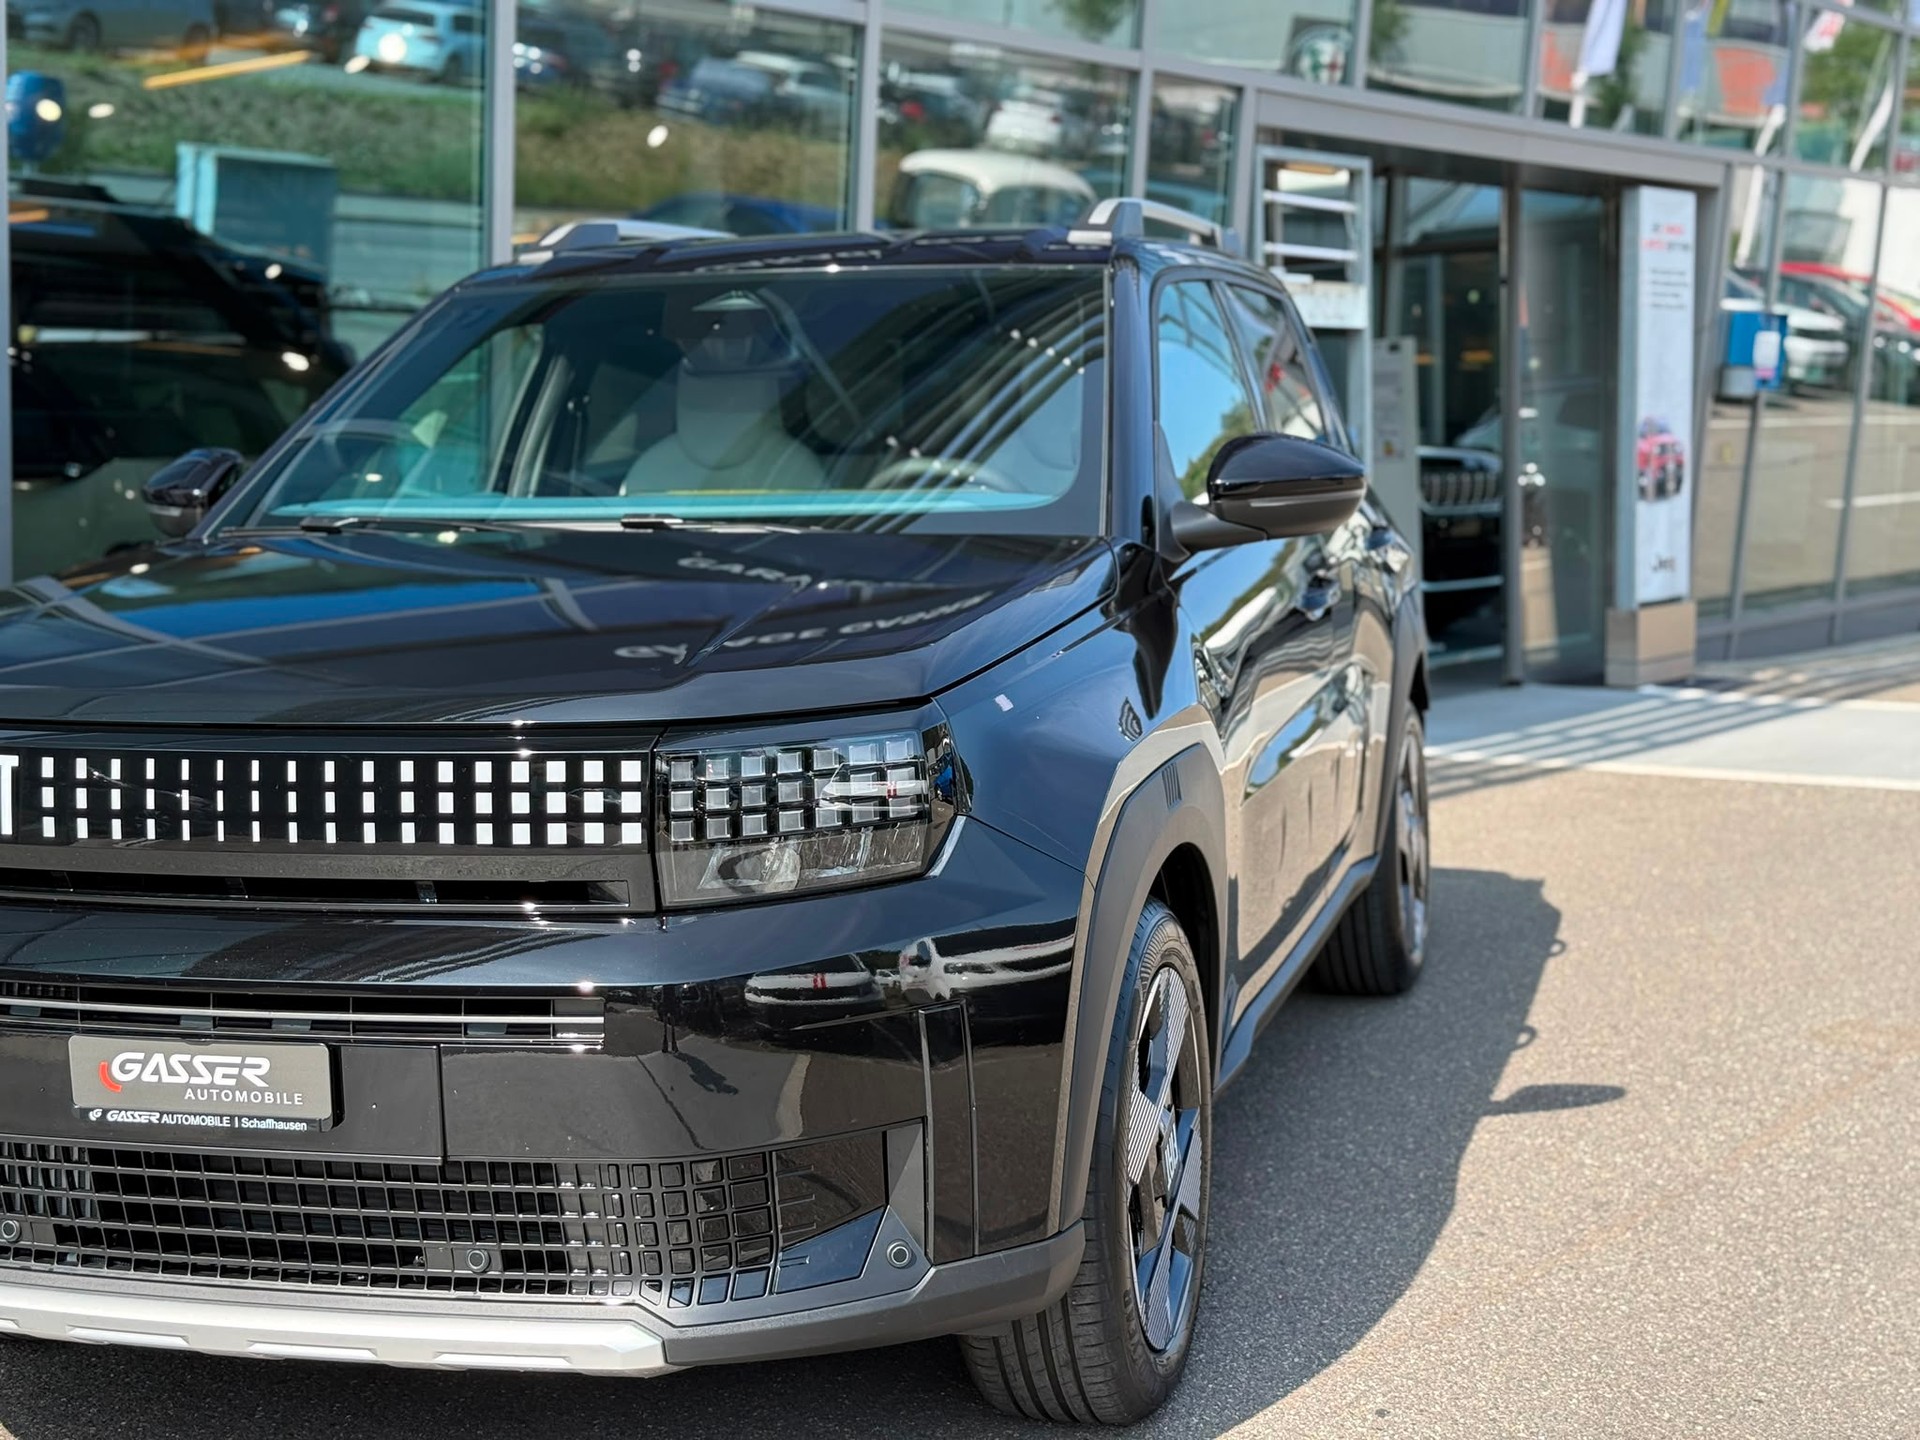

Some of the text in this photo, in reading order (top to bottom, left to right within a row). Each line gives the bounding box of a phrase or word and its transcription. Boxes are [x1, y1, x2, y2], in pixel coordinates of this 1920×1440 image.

[111, 1052, 271, 1087] GASSER
[184, 1088, 303, 1105] AUTOMOBILE
[106, 1110, 160, 1124] GASSER
[161, 1113, 231, 1127] AUTOMOBILE
[241, 1117, 308, 1131] Schaffhausen
